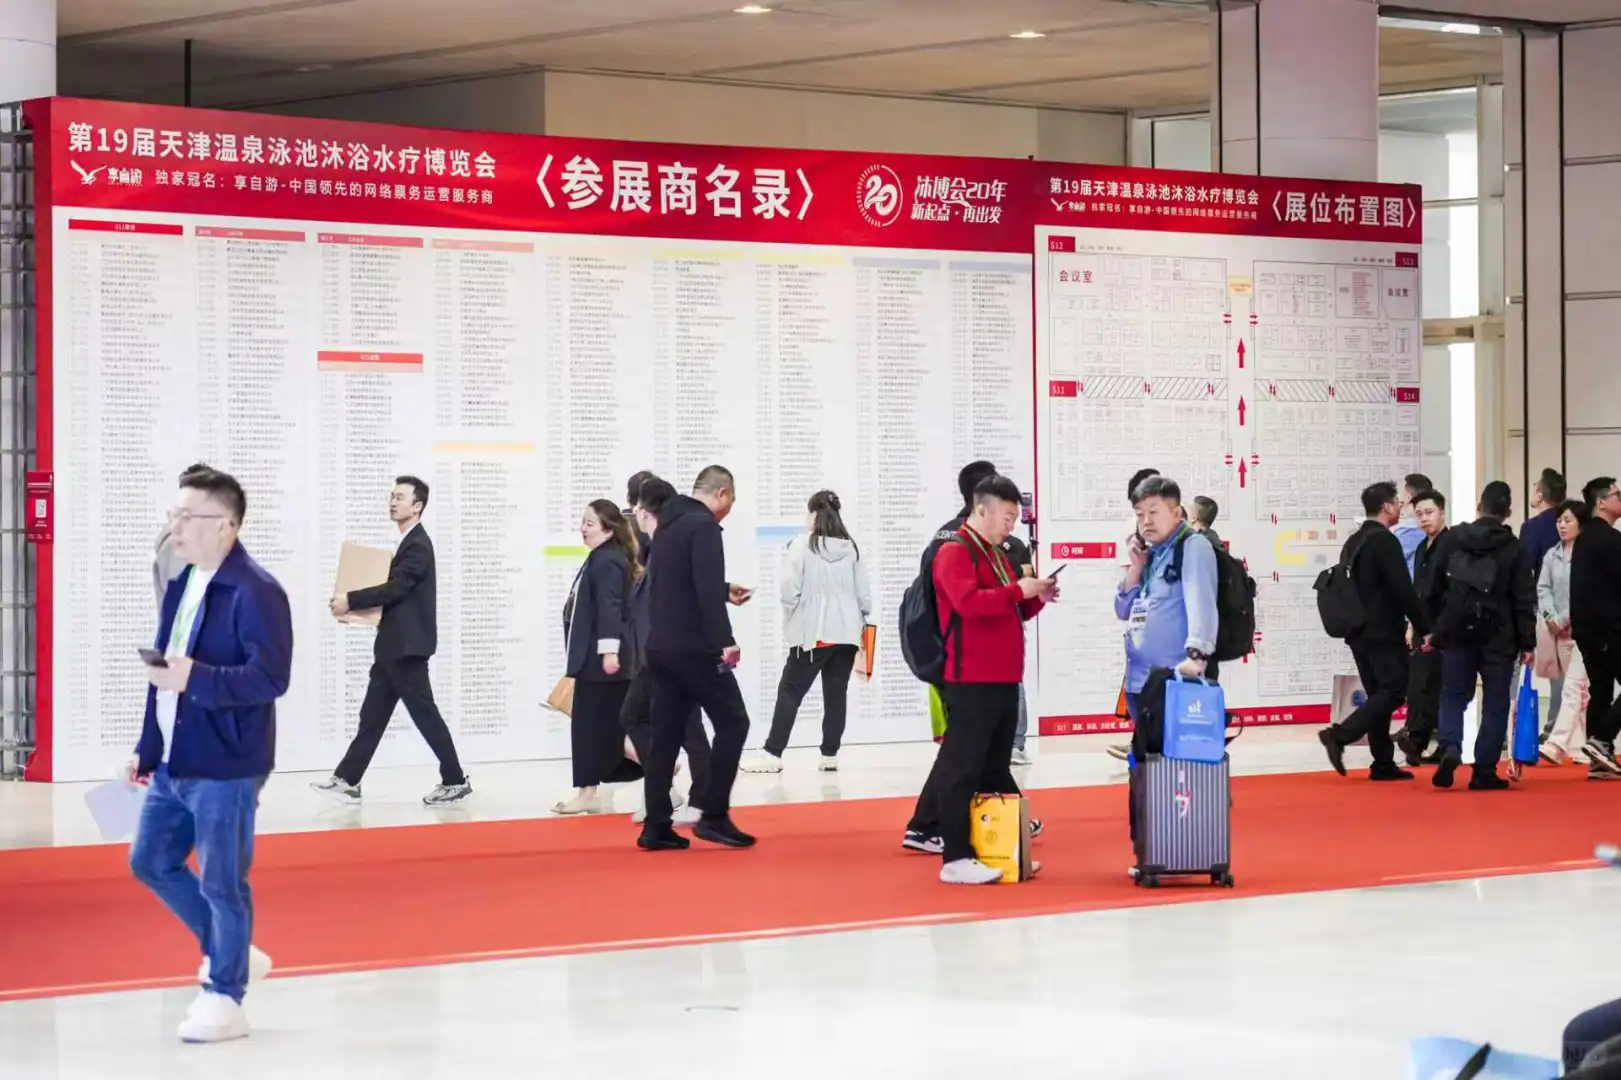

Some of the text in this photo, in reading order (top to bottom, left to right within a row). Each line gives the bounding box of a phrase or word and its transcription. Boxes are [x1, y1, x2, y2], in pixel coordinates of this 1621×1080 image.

[68, 121, 496, 179] 第19届天津温泉泳池沐浴水疗博览会
[916, 175, 1008, 203] 沐博会20年
[1050, 176, 1259, 205] 第19届天津温泉泳池沐浴水疗博览会
[1050, 241, 1064, 250] S12
[1060, 269, 1093, 283] 会议室
